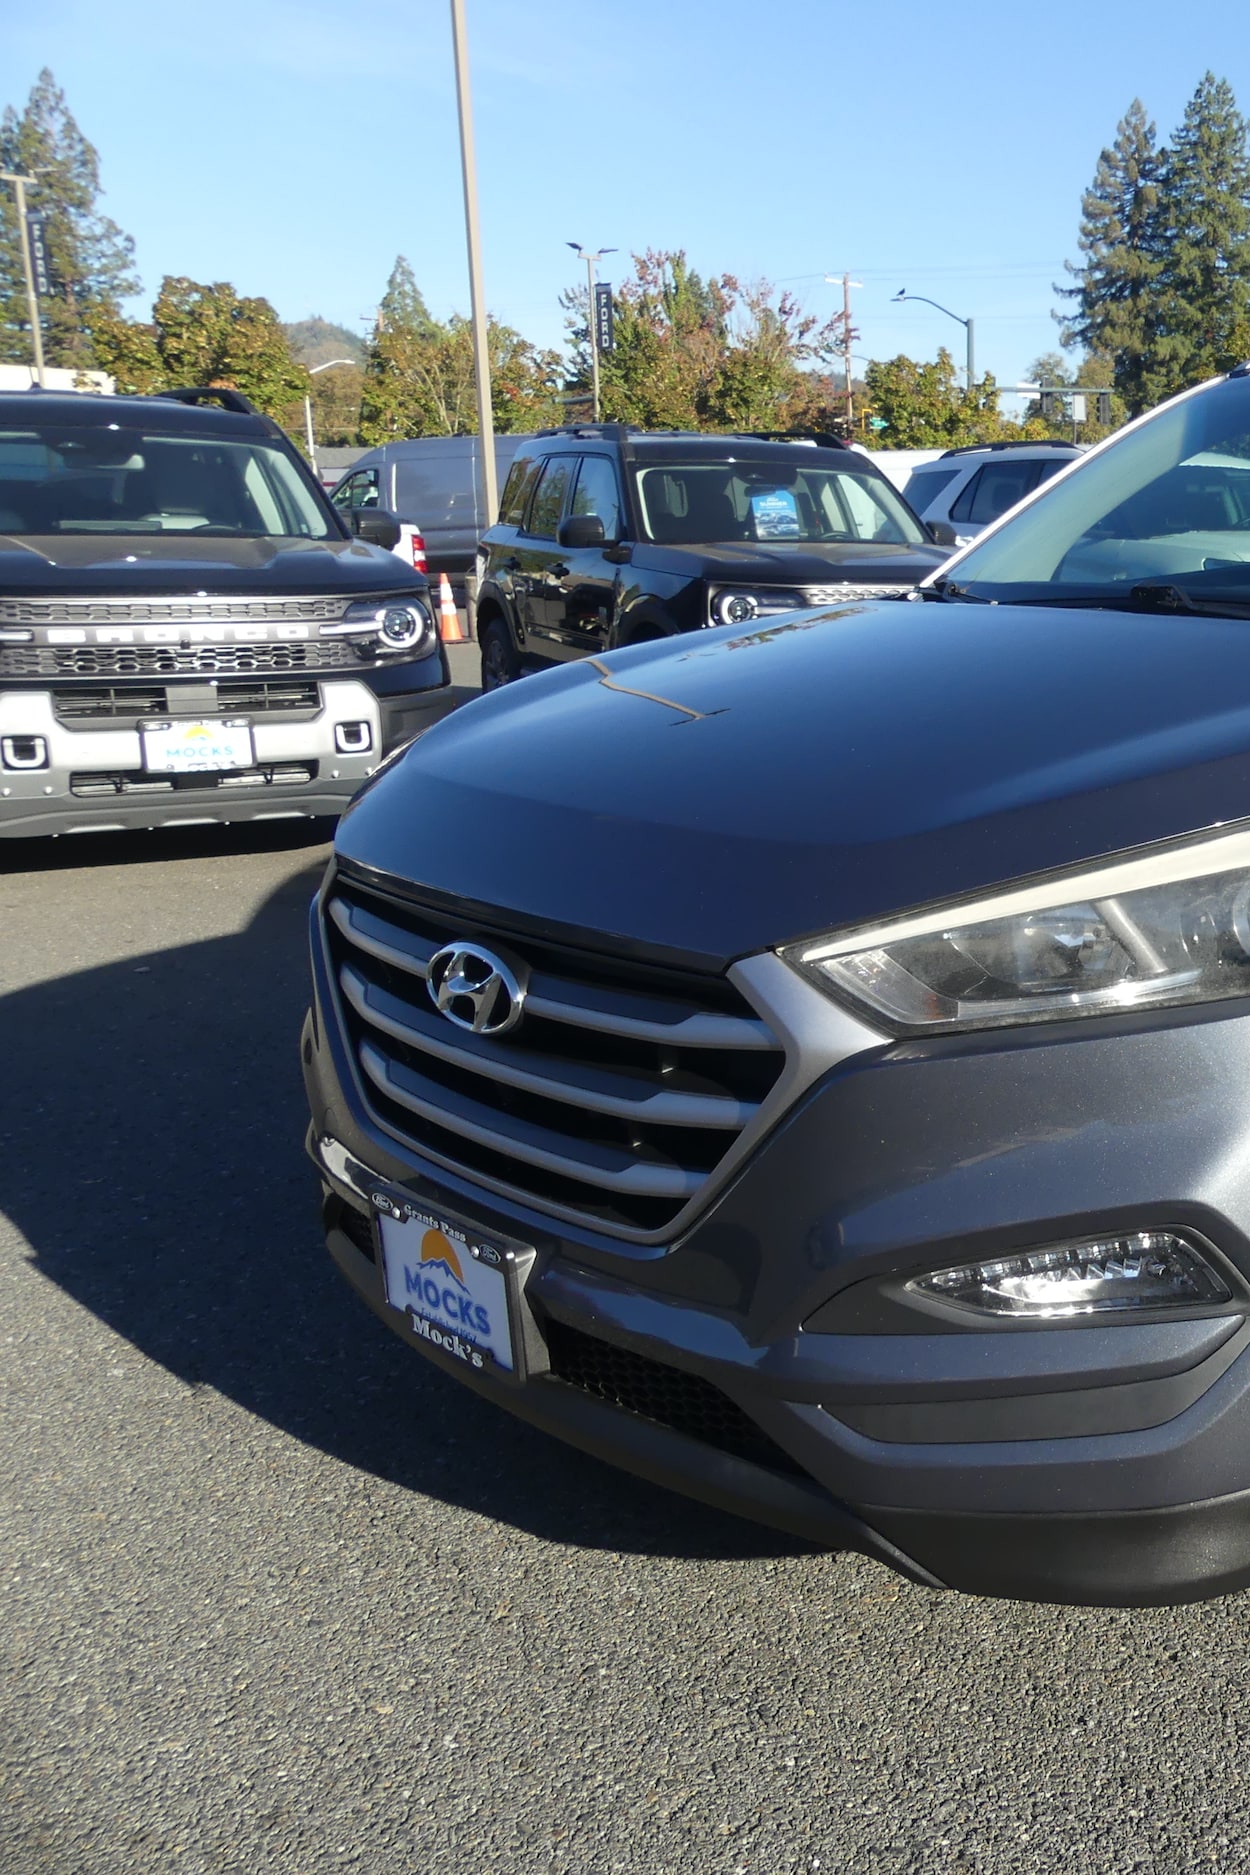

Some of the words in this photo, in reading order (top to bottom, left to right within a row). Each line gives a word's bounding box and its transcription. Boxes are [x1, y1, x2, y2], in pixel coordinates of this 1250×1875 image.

[32, 223, 48, 293] FORD
[600, 293, 610, 348] FORD
[47, 625, 309, 644] BRONCO
[166, 745, 234, 758] MOCKS
[374, 1194, 391, 1209] Ford
[404, 1204, 439, 1229] Grants
[440, 1221, 467, 1242] Pass
[403, 1264, 491, 1334] MOCKS
[411, 1313, 484, 1368] Mock's
